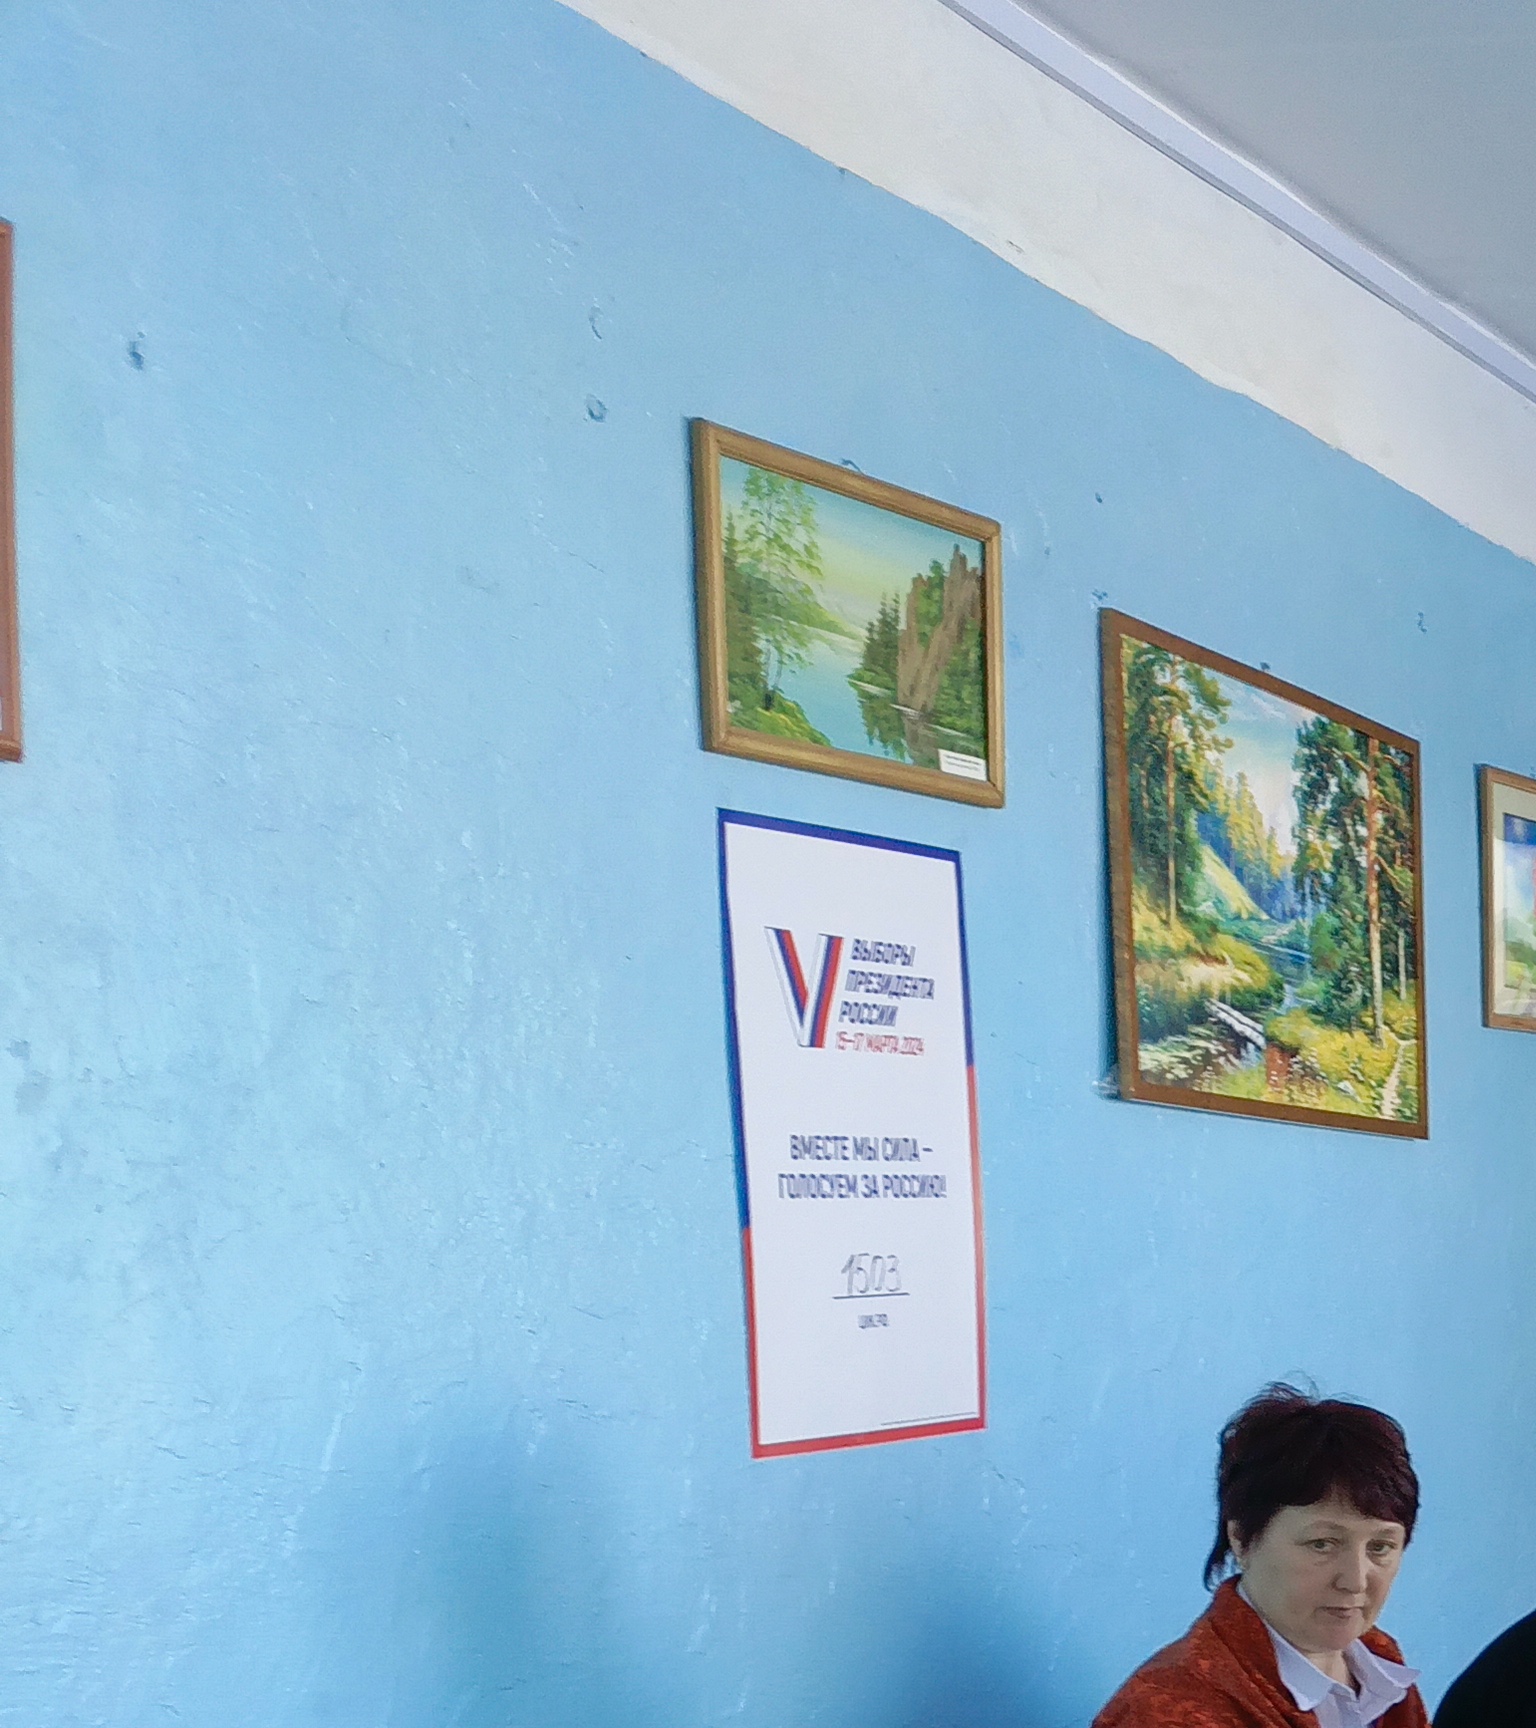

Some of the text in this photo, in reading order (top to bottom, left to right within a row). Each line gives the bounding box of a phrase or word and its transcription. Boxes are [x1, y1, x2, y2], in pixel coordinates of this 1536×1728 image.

[851, 938, 916, 967] ВЫБОРЫ
[845, 970, 935, 1000] ПРЕЗИДЕНТА
[838, 1000, 898, 1027] РОССИИ
[790, 1134, 849, 1160] ВМЕСТЕ
[852, 1136, 880, 1161] МЫ
[882, 1137, 921, 1162] СИЛА
[778, 1173, 947, 1198] ГОЛОСУЕМ ЗА РОССИЮ!
[841, 1253, 901, 1294] 1503
